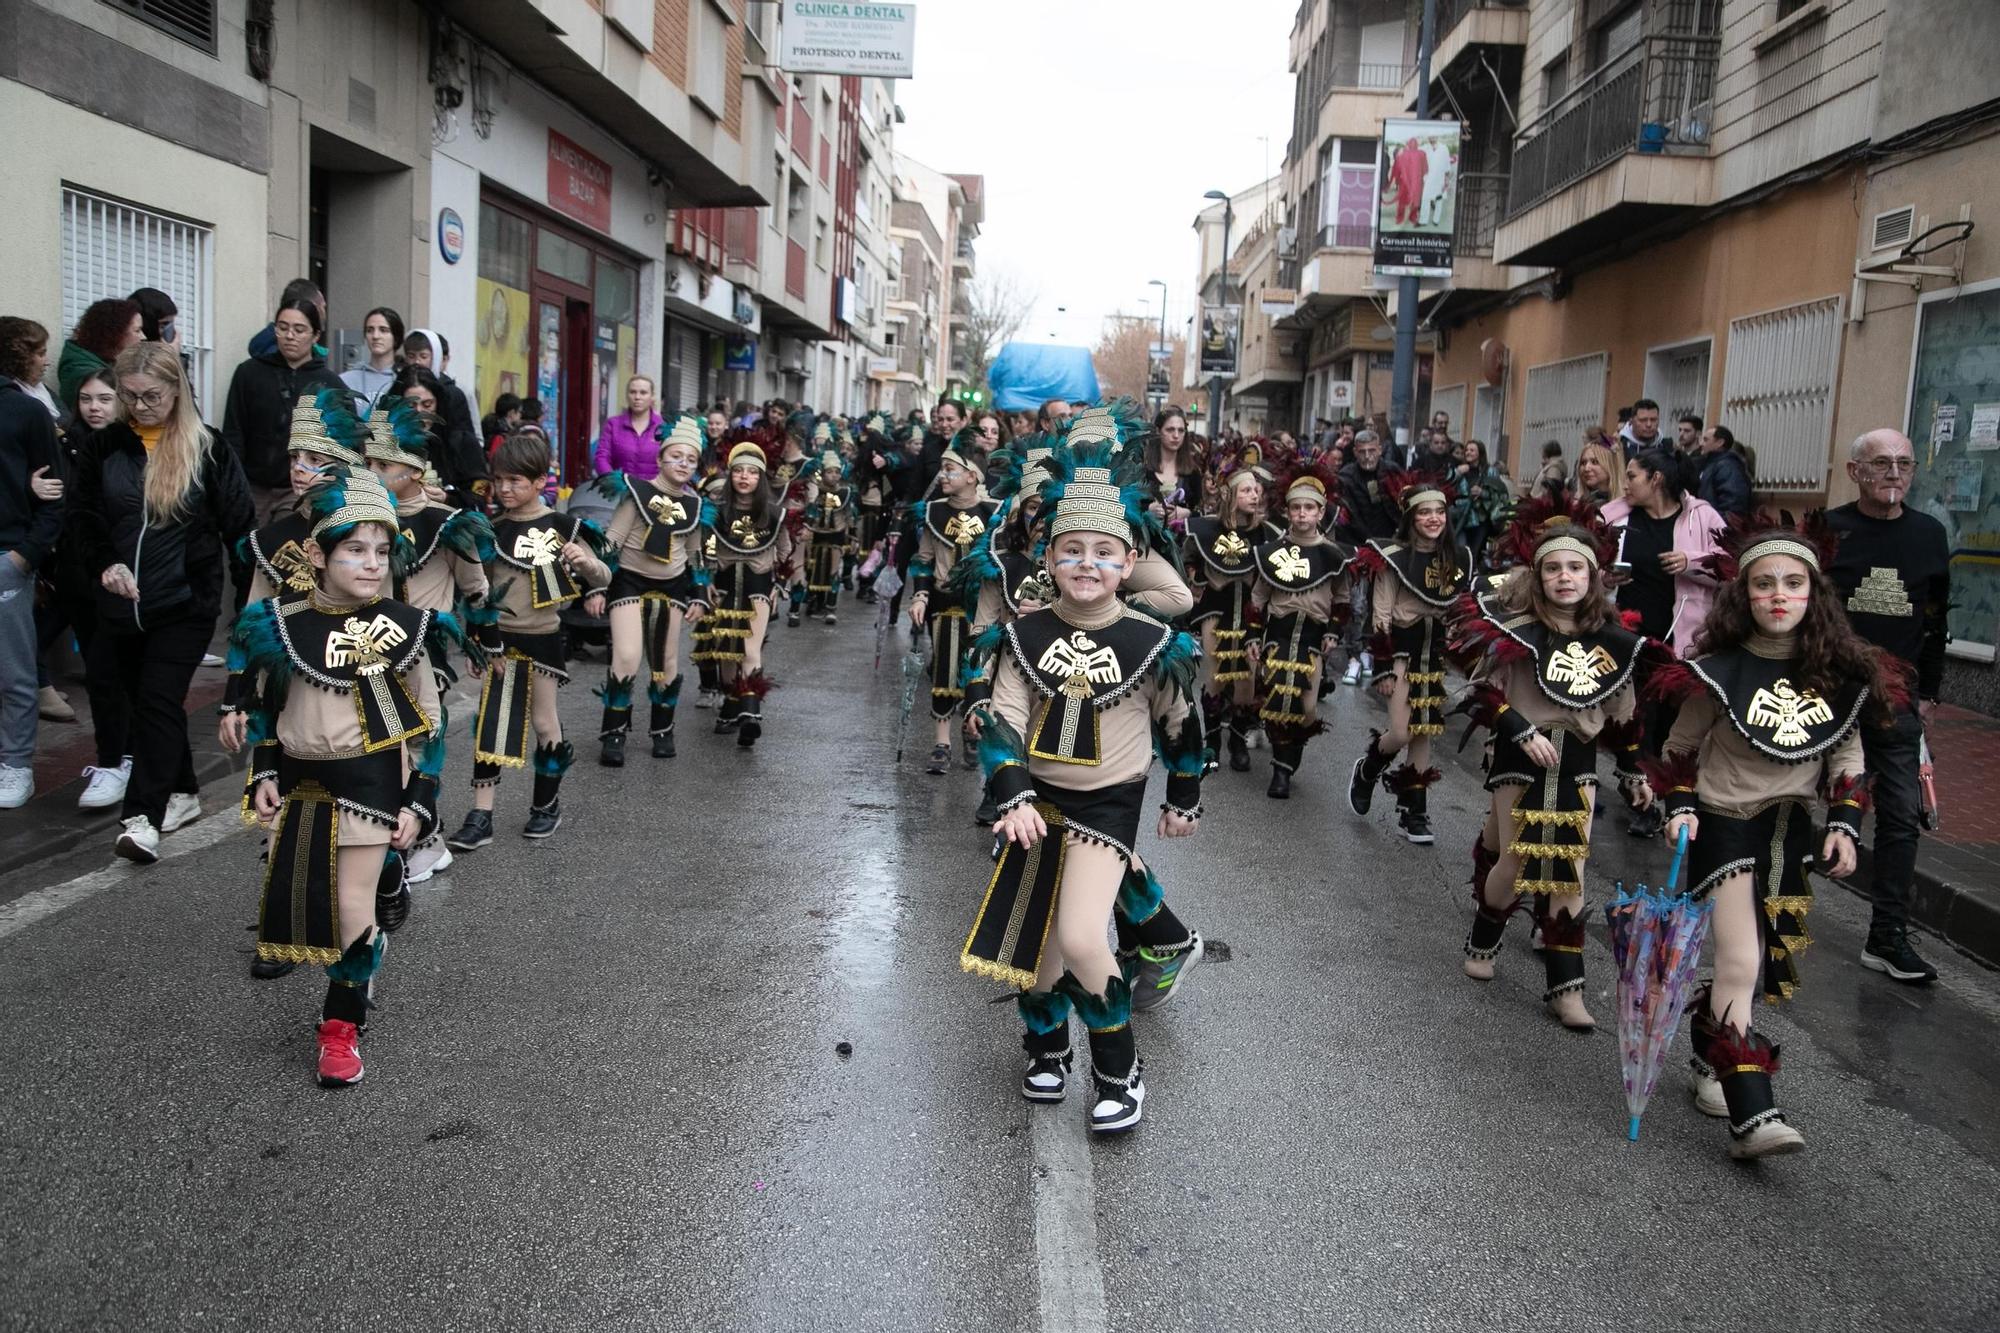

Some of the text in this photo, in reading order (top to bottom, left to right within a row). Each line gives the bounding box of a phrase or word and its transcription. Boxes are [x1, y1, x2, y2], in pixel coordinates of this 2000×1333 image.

[795, 3, 905, 18] CLINICA DENTAL
[793, 47, 904, 60] PROTESICO DENTAL
[569, 174, 596, 206] BAZAR
[1381, 237, 1450, 248] Carnaval histórico
